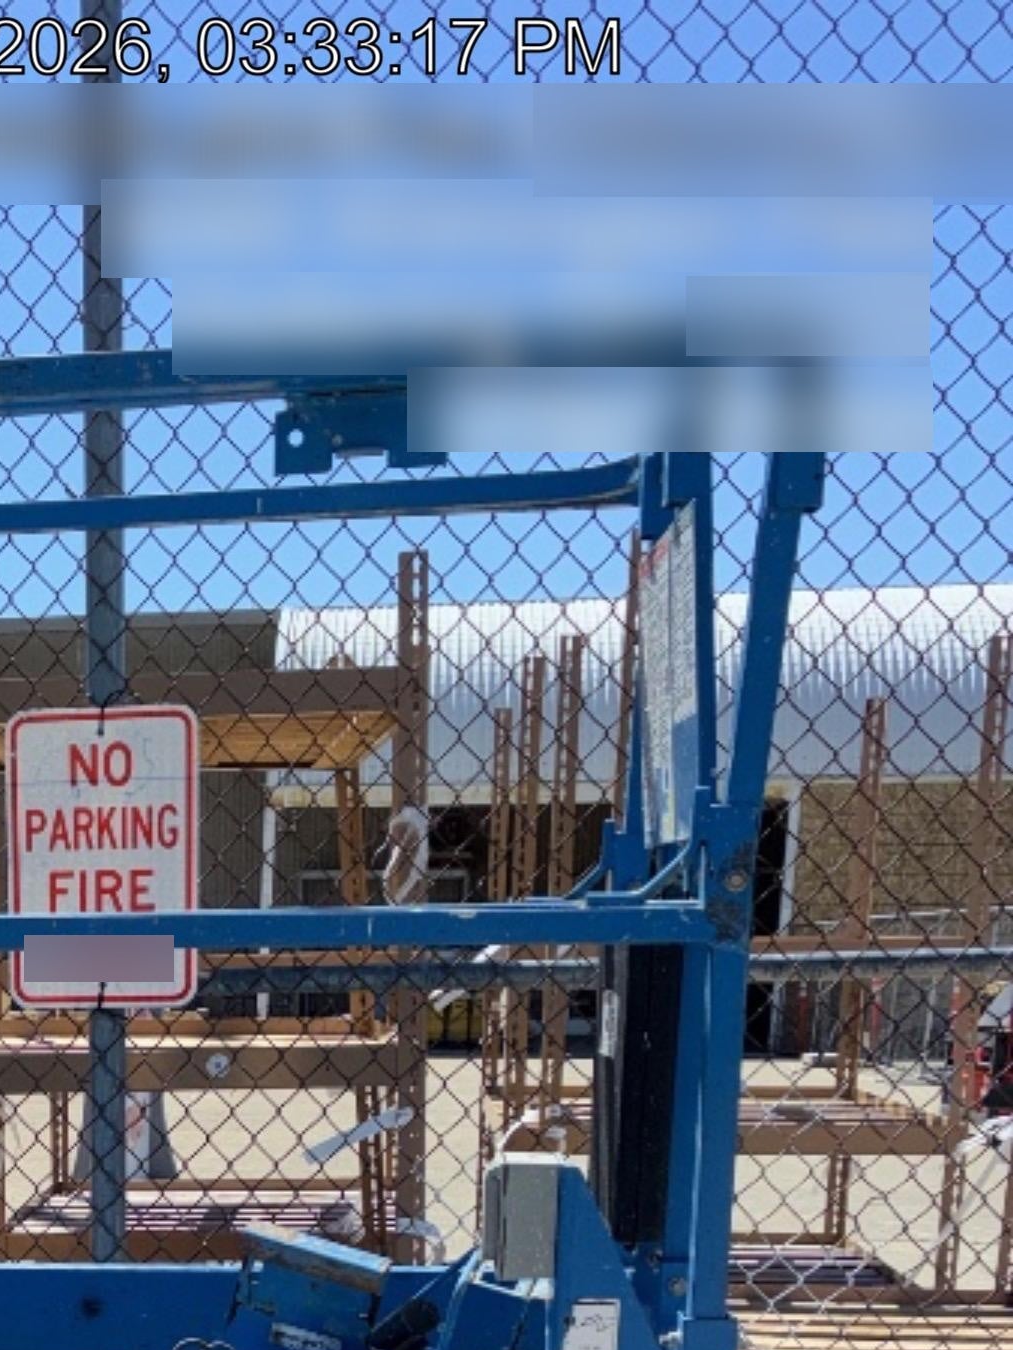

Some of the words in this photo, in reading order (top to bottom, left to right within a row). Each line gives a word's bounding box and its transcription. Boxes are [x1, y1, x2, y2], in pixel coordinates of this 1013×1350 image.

[69, 741, 133, 787] NO
[24, 804, 180, 852] PARKING
[48, 869, 156, 914] FIRE
